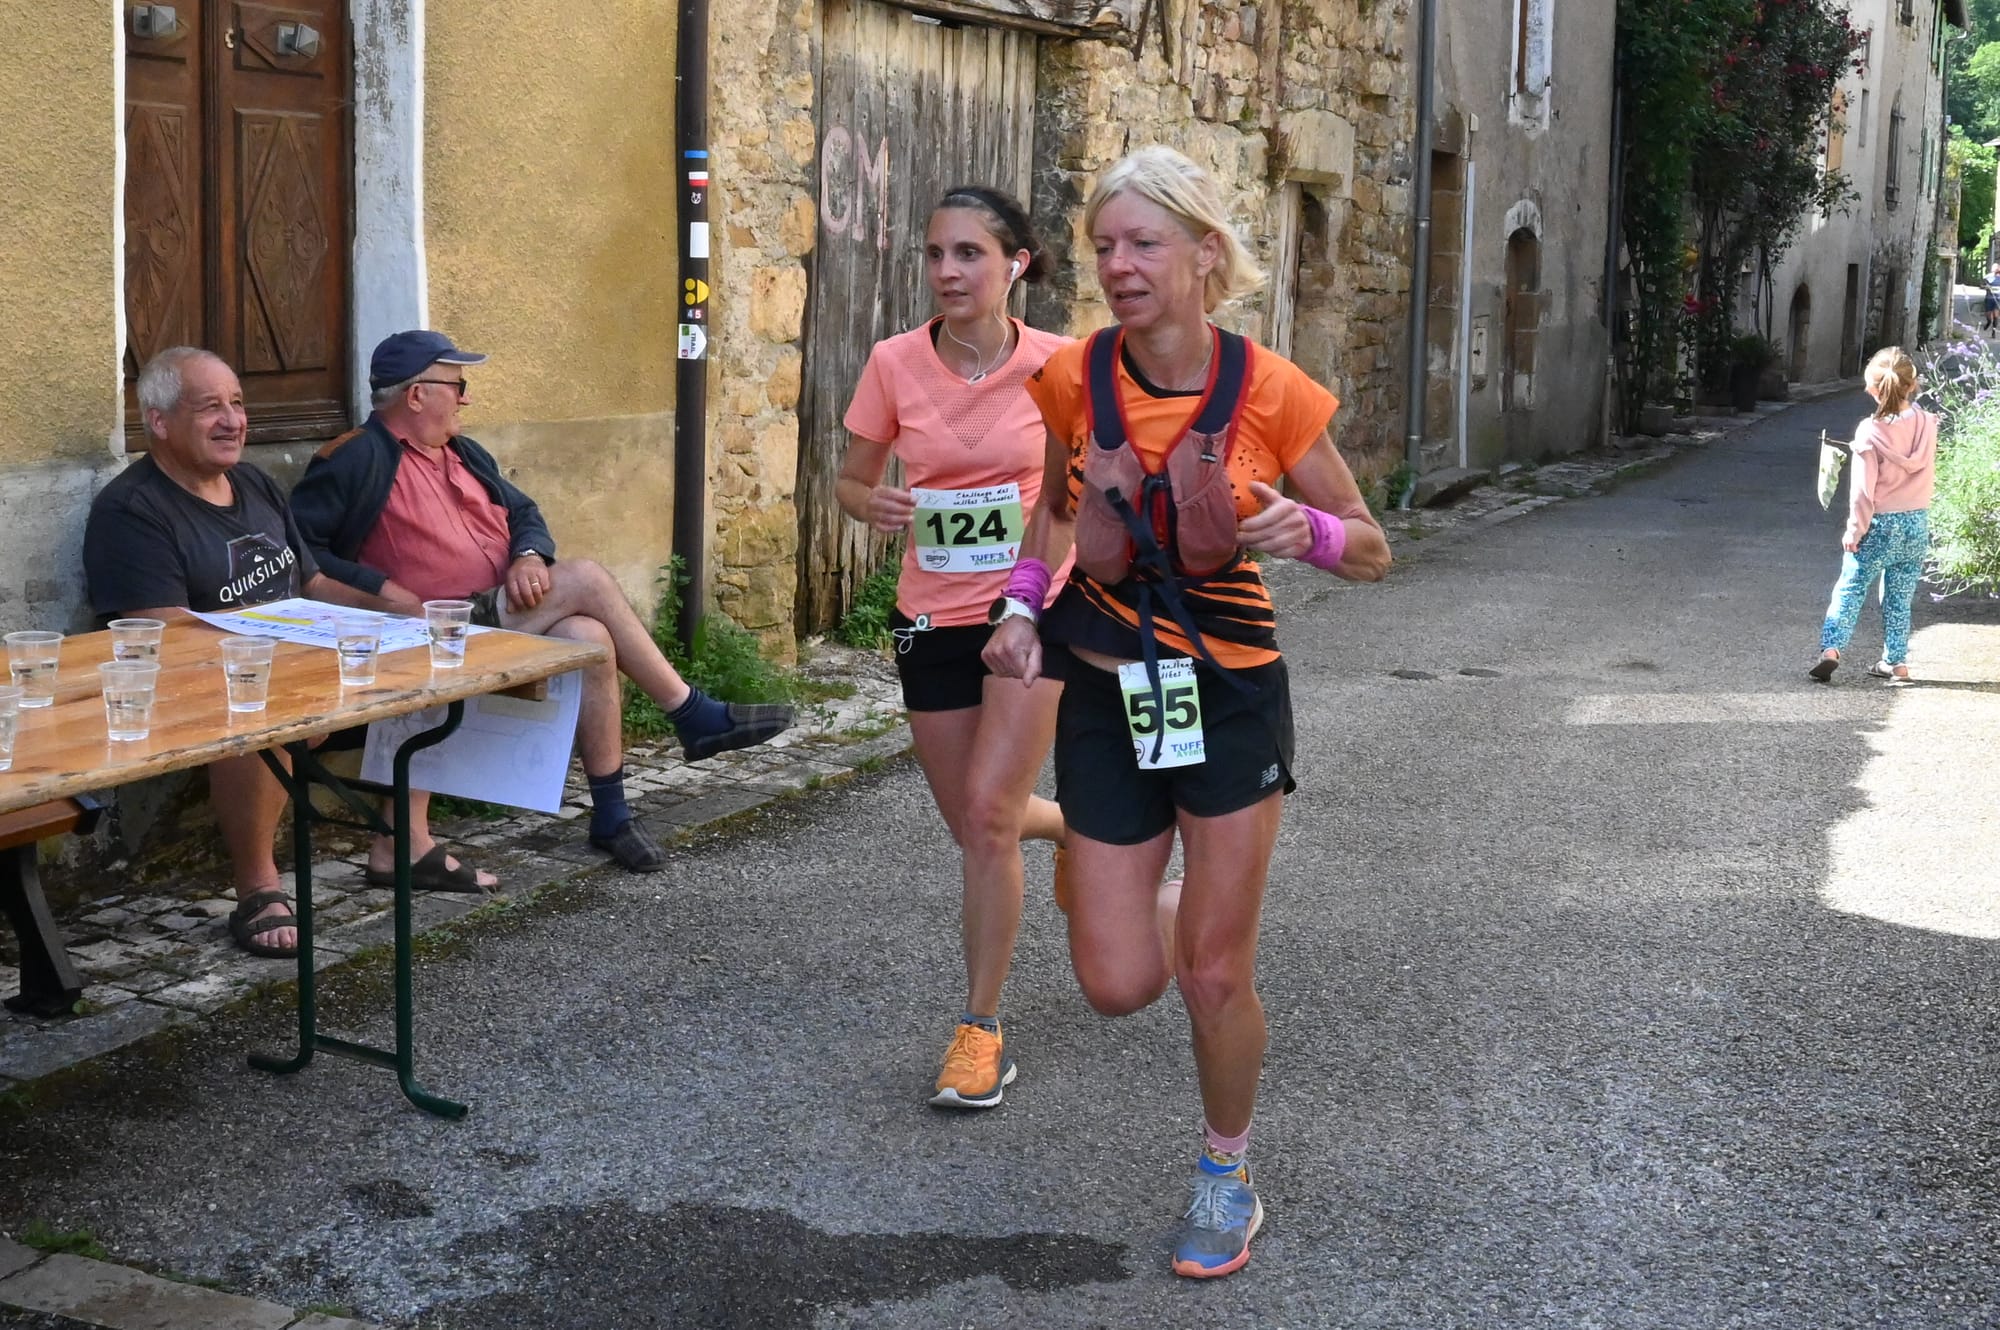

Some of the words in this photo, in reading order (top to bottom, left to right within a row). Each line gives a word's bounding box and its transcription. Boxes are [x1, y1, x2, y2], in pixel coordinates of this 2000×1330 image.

[927, 509, 1007, 545] 124
[970, 552, 1004, 561] TUFF'S
[1130, 687, 1198, 734] 55
